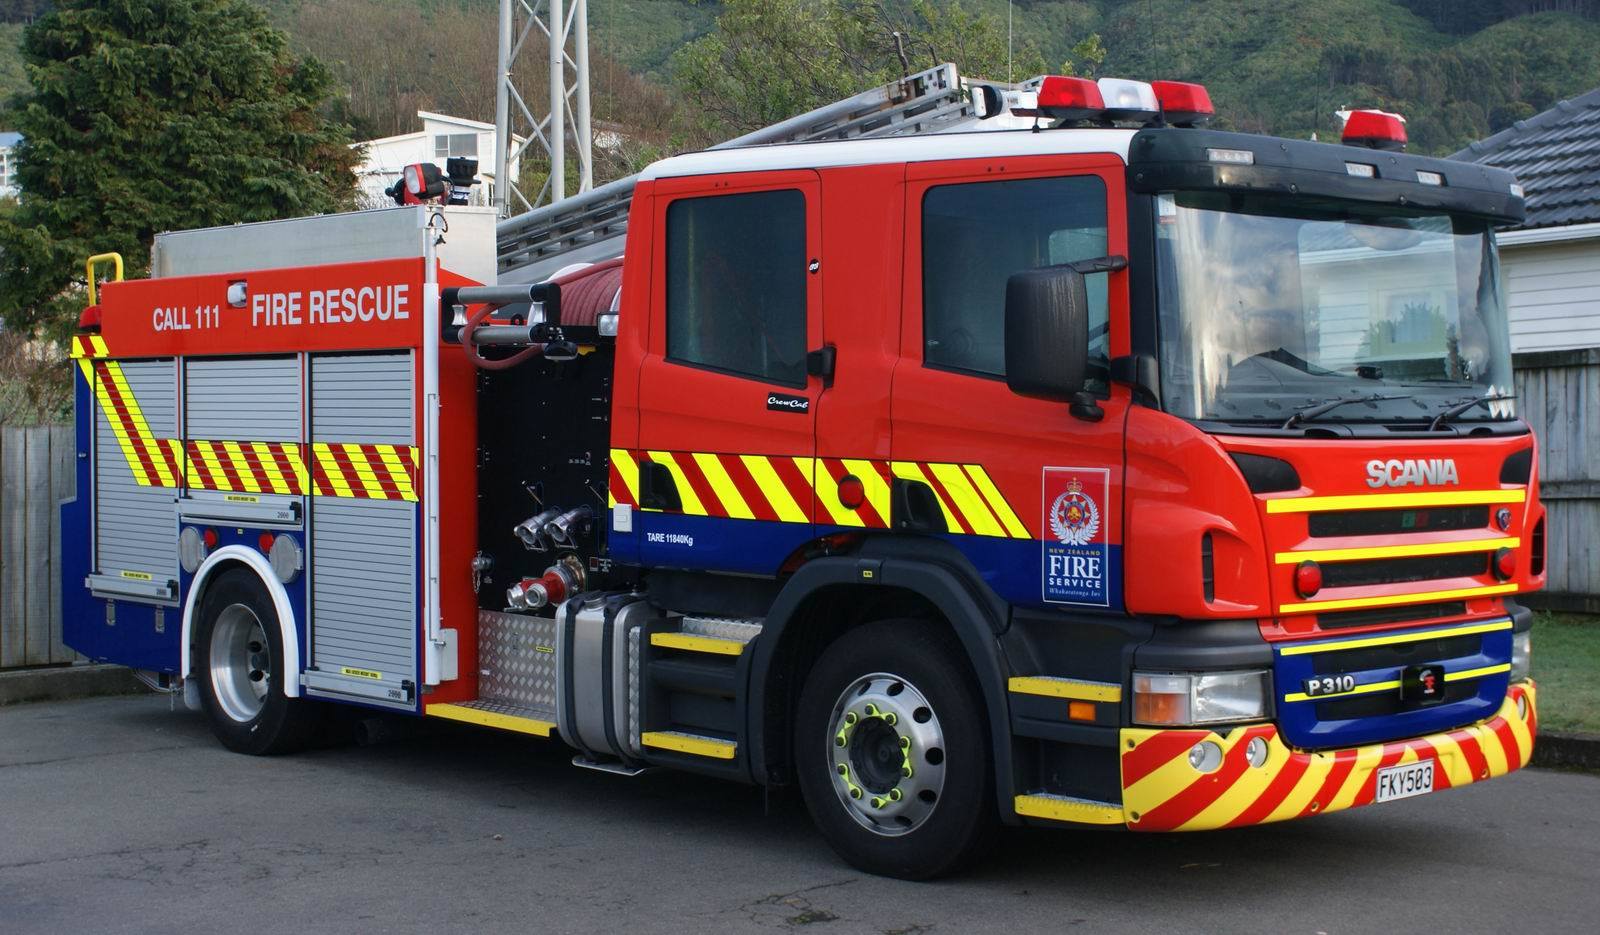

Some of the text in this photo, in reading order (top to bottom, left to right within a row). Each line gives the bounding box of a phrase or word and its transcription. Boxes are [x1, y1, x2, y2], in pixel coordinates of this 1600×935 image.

[252, 284, 410, 327] FIRE RESCUE
[153, 304, 219, 332] CALL 111
[767, 396, 809, 409] CrewCab
[1365, 458, 1460, 489] SCANIA
[647, 532, 694, 547] TARE 11840Kg
[1067, 548, 1101, 556] ZEALAND
[1048, 554, 1102, 579] FIRE
[1048, 577, 1101, 589] SERVICE
[1308, 675, 1355, 695] P 310
[1379, 766, 1432, 798] FKY503
